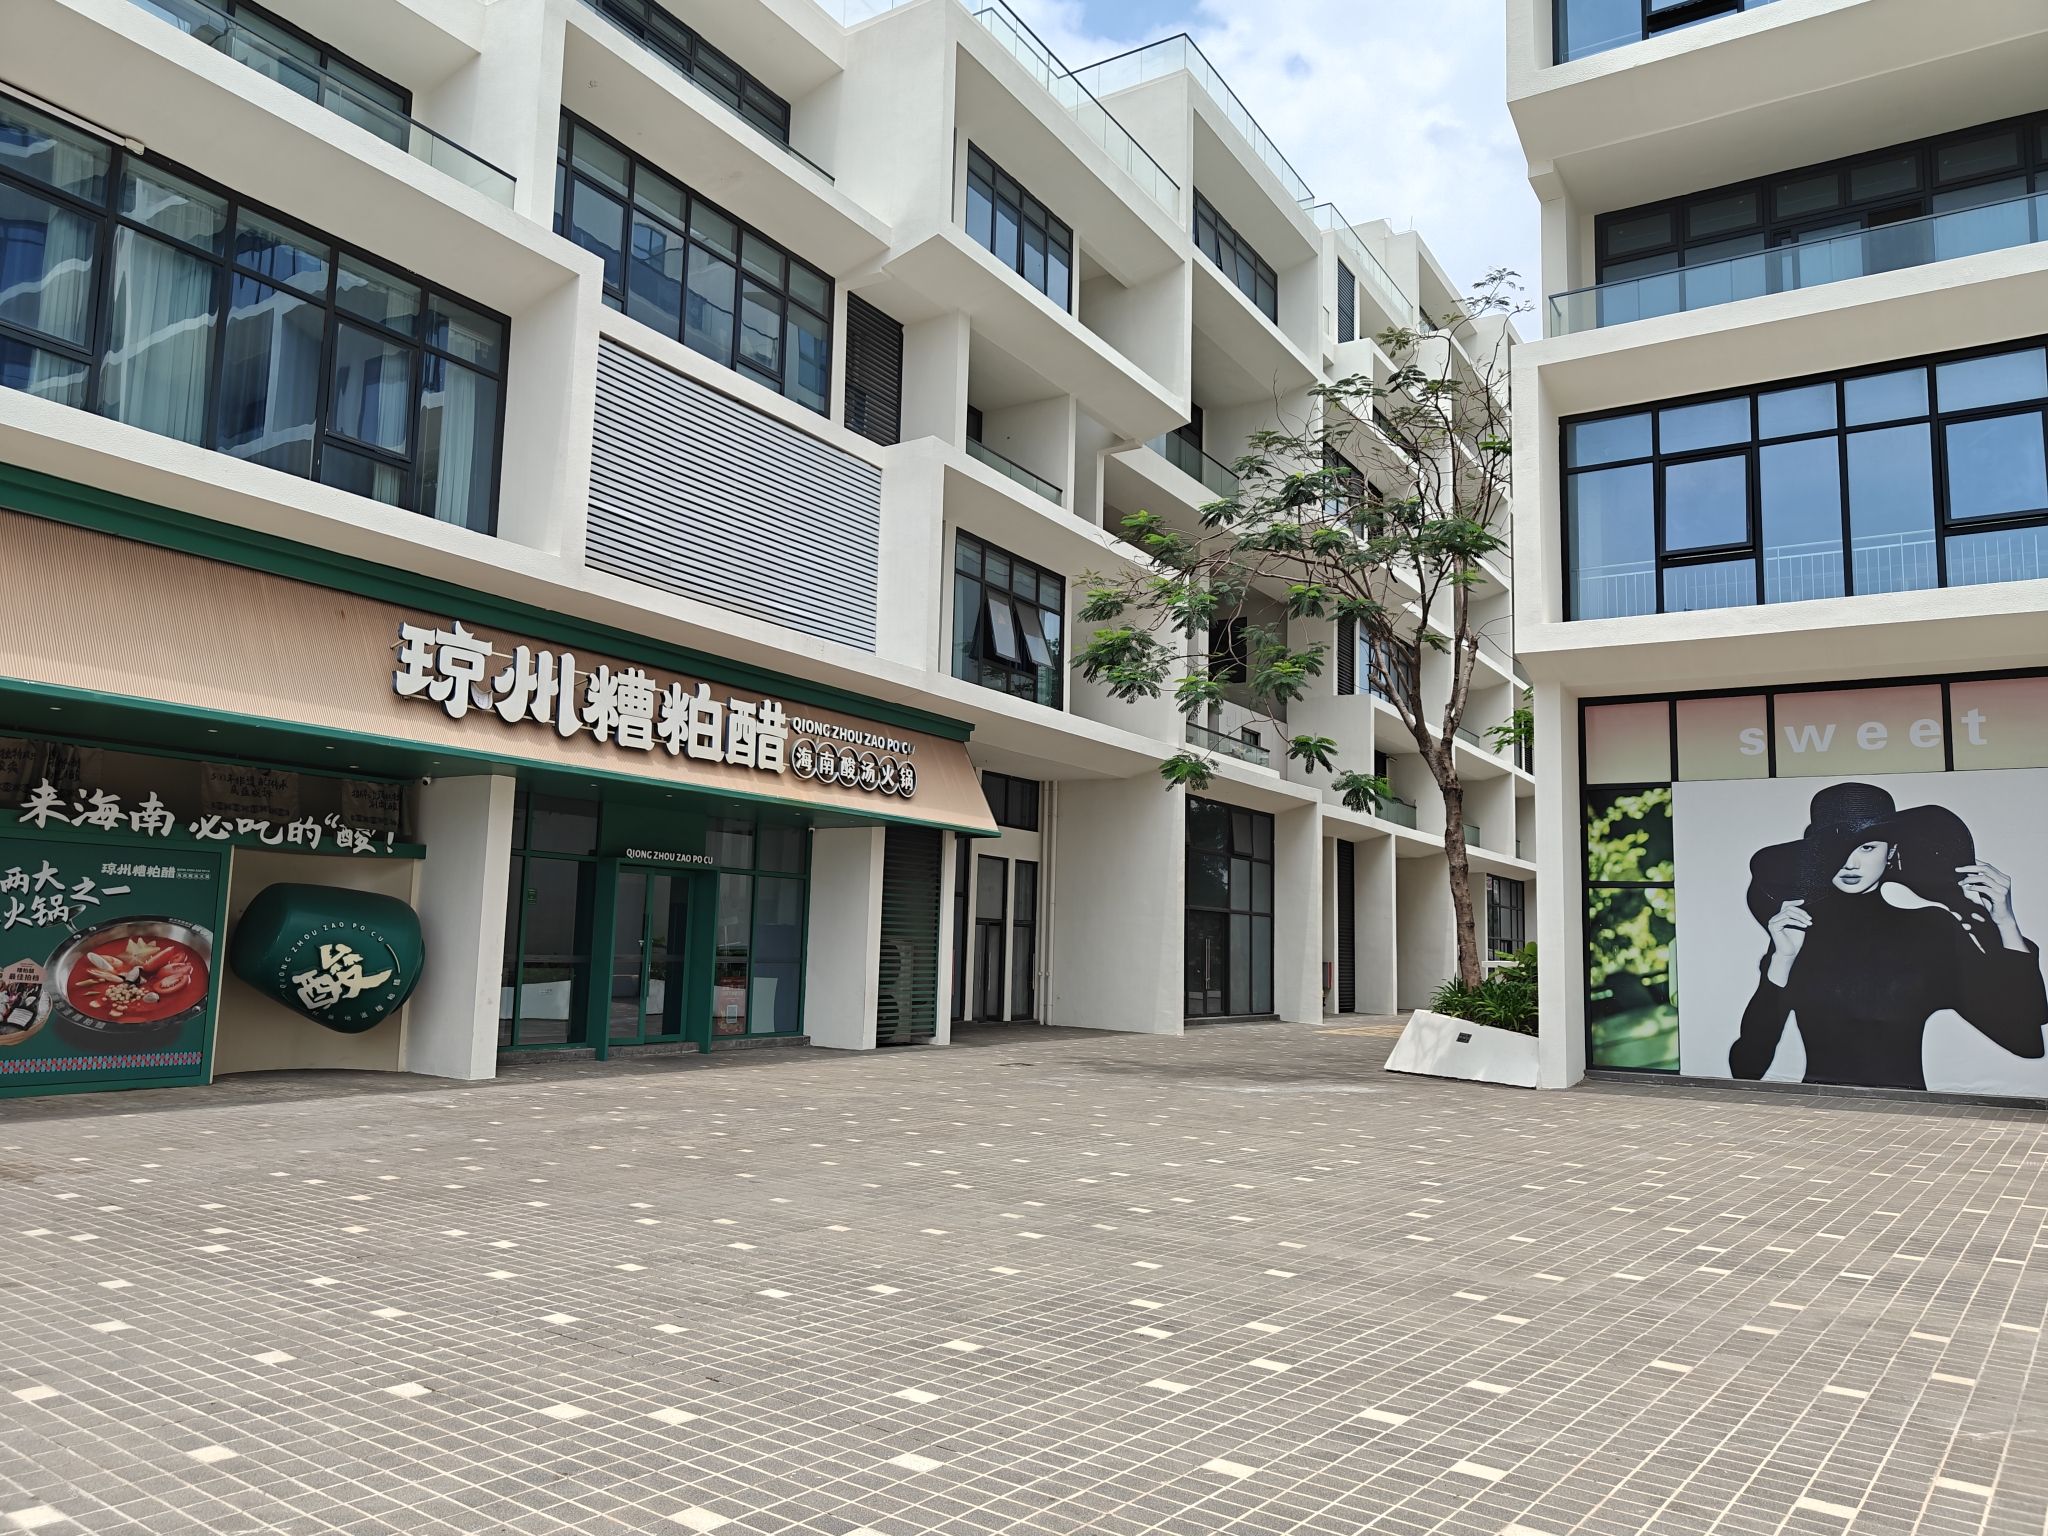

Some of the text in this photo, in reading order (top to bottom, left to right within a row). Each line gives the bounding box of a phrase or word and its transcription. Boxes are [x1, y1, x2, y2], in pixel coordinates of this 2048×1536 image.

[393, 620, 788, 774] 琼州糟粕醋
[793, 717, 830, 738] QIONG
[832, 725, 863, 744] ZHOU
[864, 732, 885, 749] ZAO
[887, 738, 900, 752] PO
[1739, 708, 1988, 756] sweet
[795, 746, 915, 792] 海南酸汤火锅
[19, 777, 176, 837] 来海南
[101, 862, 176, 879] 琼州糟粕醋
[626, 848, 713, 865] QIONG ZHOU ZAO PO CU
[291, 930, 317, 953] ZHOU
[322, 921, 344, 931] ZAO
[352, 922, 365, 931] PO
[371, 931, 384, 942] CU
[292, 943, 393, 1010] 酸
